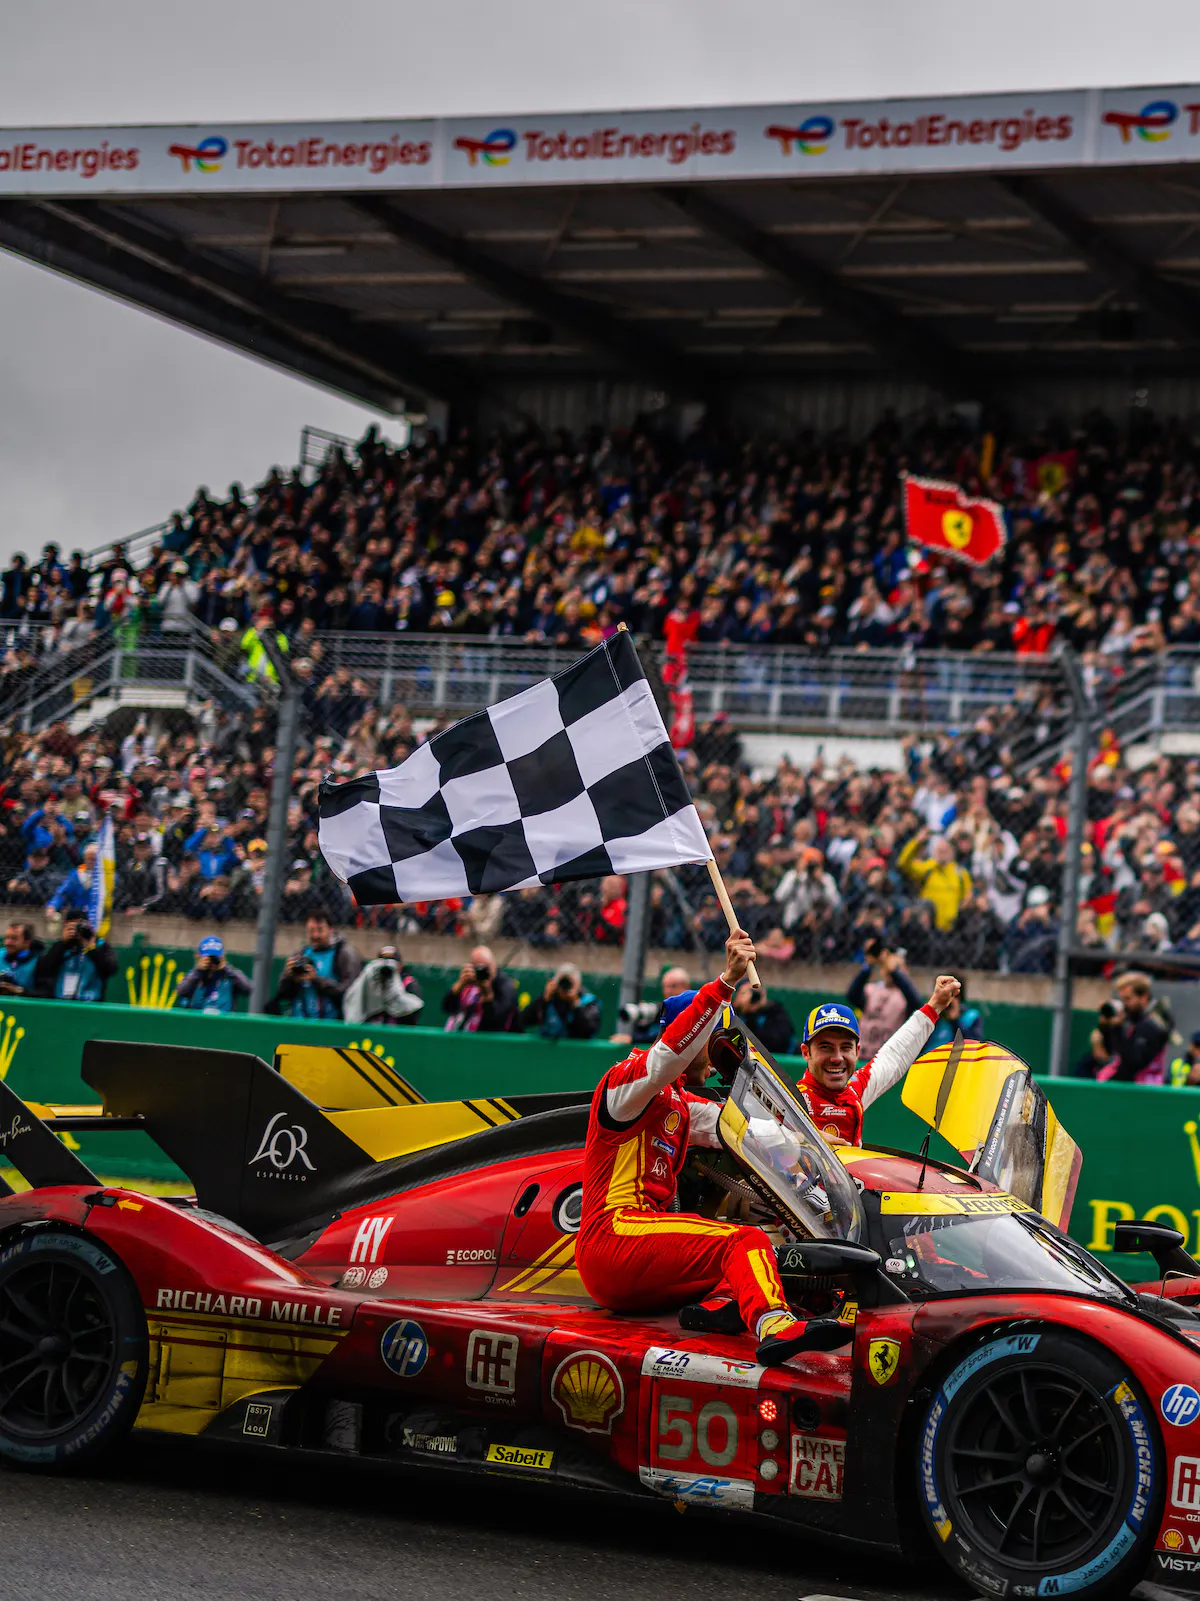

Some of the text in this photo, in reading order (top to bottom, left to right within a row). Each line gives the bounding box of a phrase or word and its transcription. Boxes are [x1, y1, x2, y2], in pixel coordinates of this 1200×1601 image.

[523, 121, 735, 164] TotalEnergies
[842, 109, 1072, 151] TotalEnergies
[234, 136, 431, 174] TotalEnergies
[815, 1016, 850, 1026] MICHELIN
[256, 1171, 308, 1182] ESPRESSO
[350, 1216, 395, 1263] HY
[456, 1249, 497, 1262] ECOPOL
[156, 1288, 343, 1327] RICHARD MILLE
[386, 1320, 424, 1378] hp
[967, 1347, 994, 1369] SPORT
[715, 1374, 749, 1384] TotalEnergies
[1164, 1385, 1199, 1426] hp
[658, 1394, 739, 1466] 50
[494, 1446, 548, 1467] Sabelt
[922, 1400, 944, 1502] MICHELIN
[1131, 1420, 1152, 1522] MICHELIN
